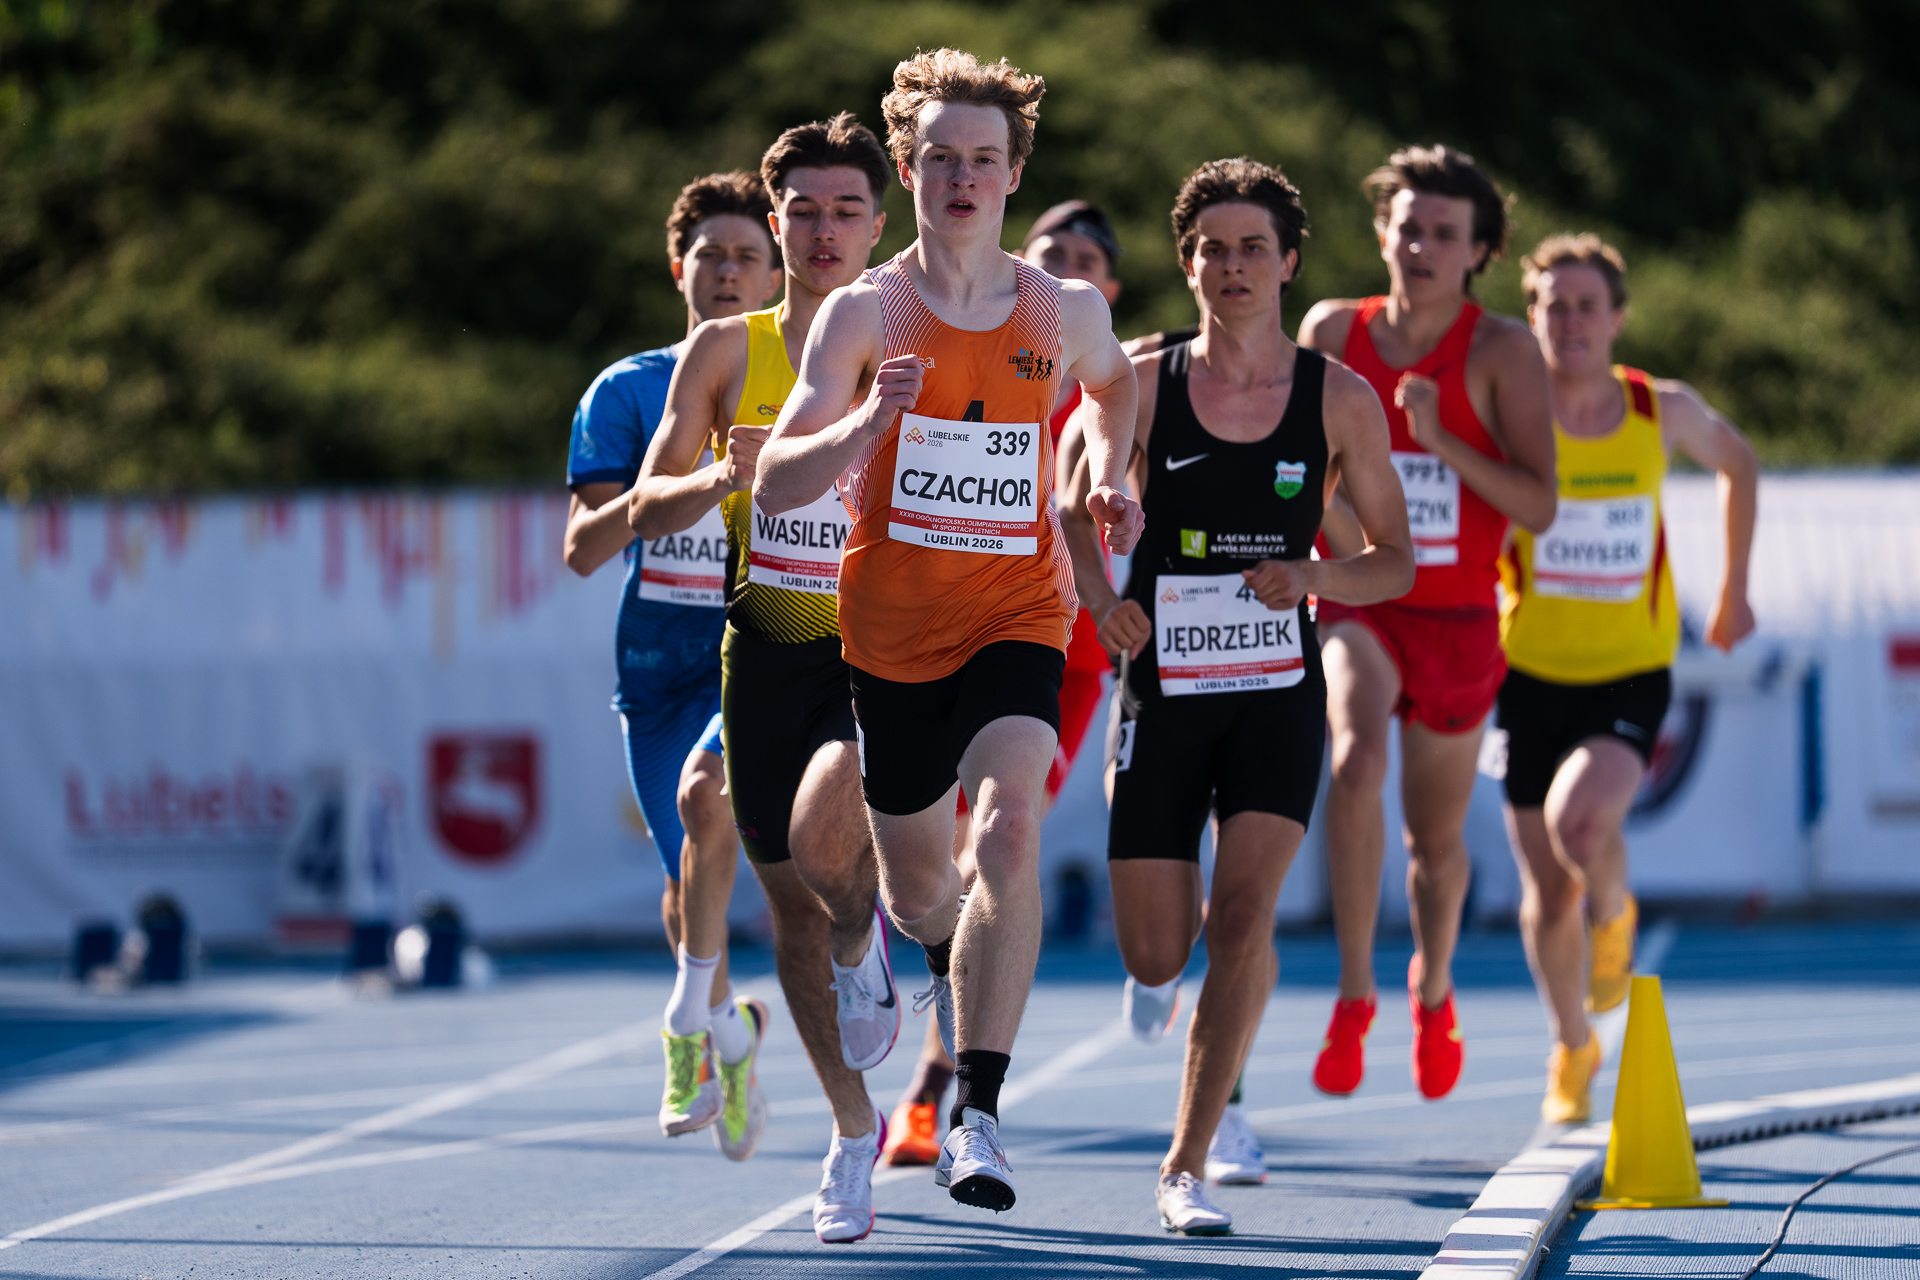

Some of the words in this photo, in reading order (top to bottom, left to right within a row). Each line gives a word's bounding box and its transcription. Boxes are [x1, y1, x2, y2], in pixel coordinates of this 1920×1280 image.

[1008, 355, 1034, 365] LEMIESZ
[1016, 364, 1034, 373] TEAM
[928, 429, 970, 442] LUBELSKIE
[927, 439, 943, 448] 2026
[985, 430, 1031, 456] 339
[900, 468, 1032, 507] CZACHOR
[898, 510, 915, 519] XXXII
[915, 513, 966, 525] OGÓLNOPOLSKA
[967, 520, 1001, 529] OLIMPIADA
[1001, 521, 1030, 530] MŁODZIEŻY
[757, 512, 849, 550] WASILEW
[940, 524, 974, 533] SPORTACH
[975, 527, 1001, 535] LETNICH
[924, 533, 969, 547] LUBLIN
[971, 537, 1004, 550] 2026
[1254, 534, 1284, 543] BANK
[780, 575, 822, 589] LUBLIN
[1181, 586, 1220, 596] LUBELSKIE
[1163, 619, 1293, 658] JĘDRZEJEK
[1195, 680, 1236, 691] LUBLIN
[1238, 676, 1270, 687] 2026
